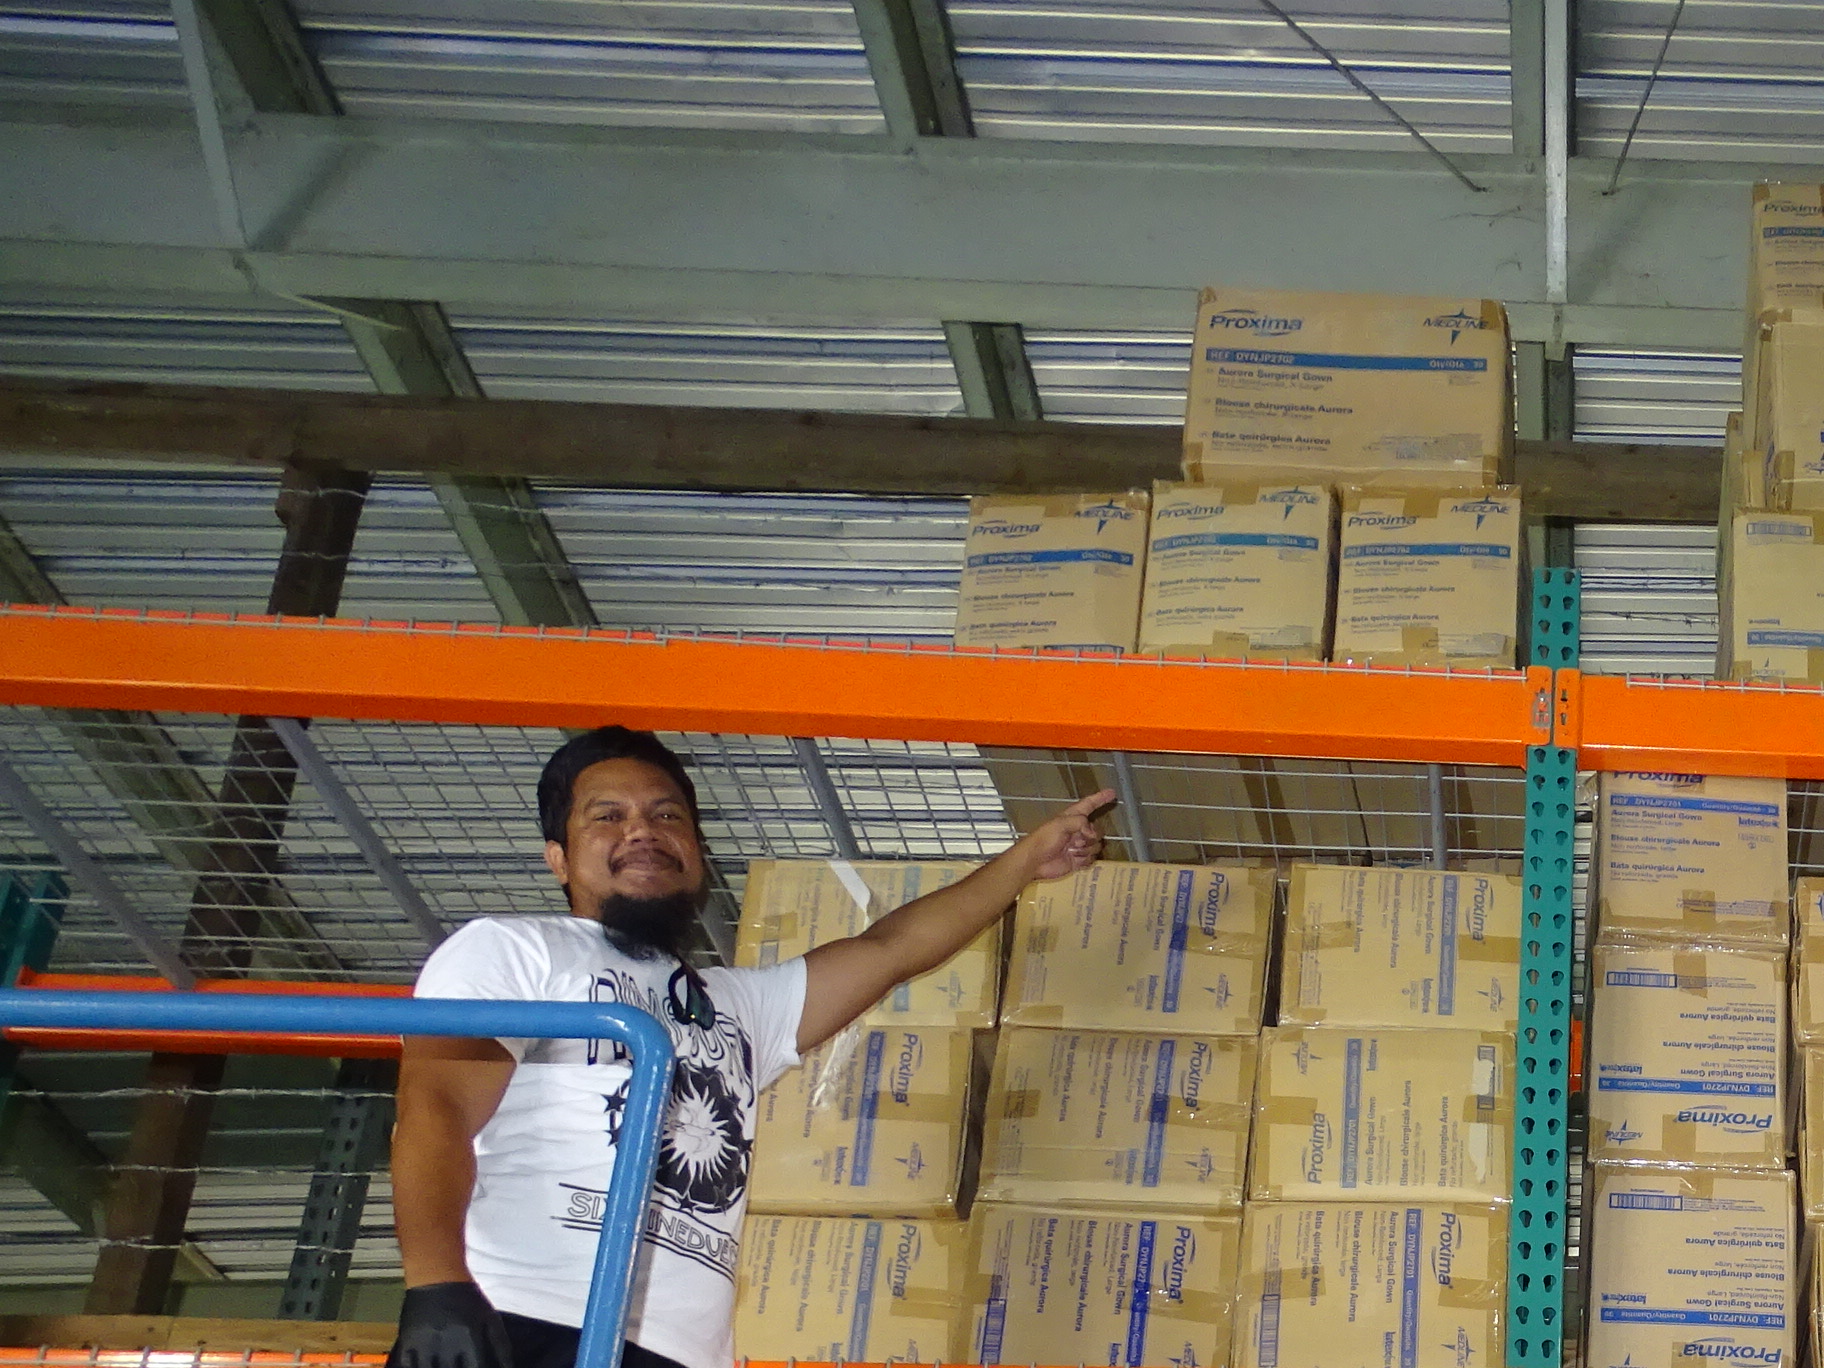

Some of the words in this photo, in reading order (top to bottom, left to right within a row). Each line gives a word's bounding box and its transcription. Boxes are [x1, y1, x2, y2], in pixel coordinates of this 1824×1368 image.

[1209, 313, 1304, 332] Proxima
[1423, 316, 1488, 331] MEDLINE
[1218, 367, 1254, 378] Aurora
[1257, 369, 1300, 382] Surgical
[1303, 373, 1333, 383] Gown
[1074, 508, 1135, 521] MEDLINE
[1157, 504, 1224, 520] Proxima
[1451, 504, 1510, 516] MEDLINE
[1348, 515, 1417, 528] Proxima
[972, 523, 1040, 537] Proxima
[1202, 872, 1224, 936] Proxima
[1472, 878, 1489, 941] Proxima
[896, 1032, 918, 1103] Proxima
[1680, 1069, 1706, 1077] Gown
[1708, 1069, 1744, 1079] Surgical
[1186, 1042, 1208, 1108] Proxima
[1746, 1071, 1775, 1080] Aurora
[1703, 1082, 1750, 1093] DYNJP2701
[1678, 1110, 1773, 1129] Proxima
[1308, 1112, 1326, 1185] Proxima
[1685, 1237, 1716, 1245] Aurora
[1765, 1241, 1785, 1249] Bata
[1439, 1212, 1456, 1285] Proxima
[892, 1224, 917, 1298] Proxima
[1169, 1226, 1191, 1300] Proxima
[1667, 1268, 1698, 1277] Aurora
[1700, 1269, 1753, 1280] chirurgicale
[1755, 1272, 1785, 1281] Blouse
[1686, 1298, 1712, 1307] Gown
[1714, 1299, 1752, 1310] Surgical
[1754, 1301, 1784, 1310] Aurora
[1709, 1313, 1759, 1325] DYNJP2701
[1683, 1344, 1782, 1364] Proxima
